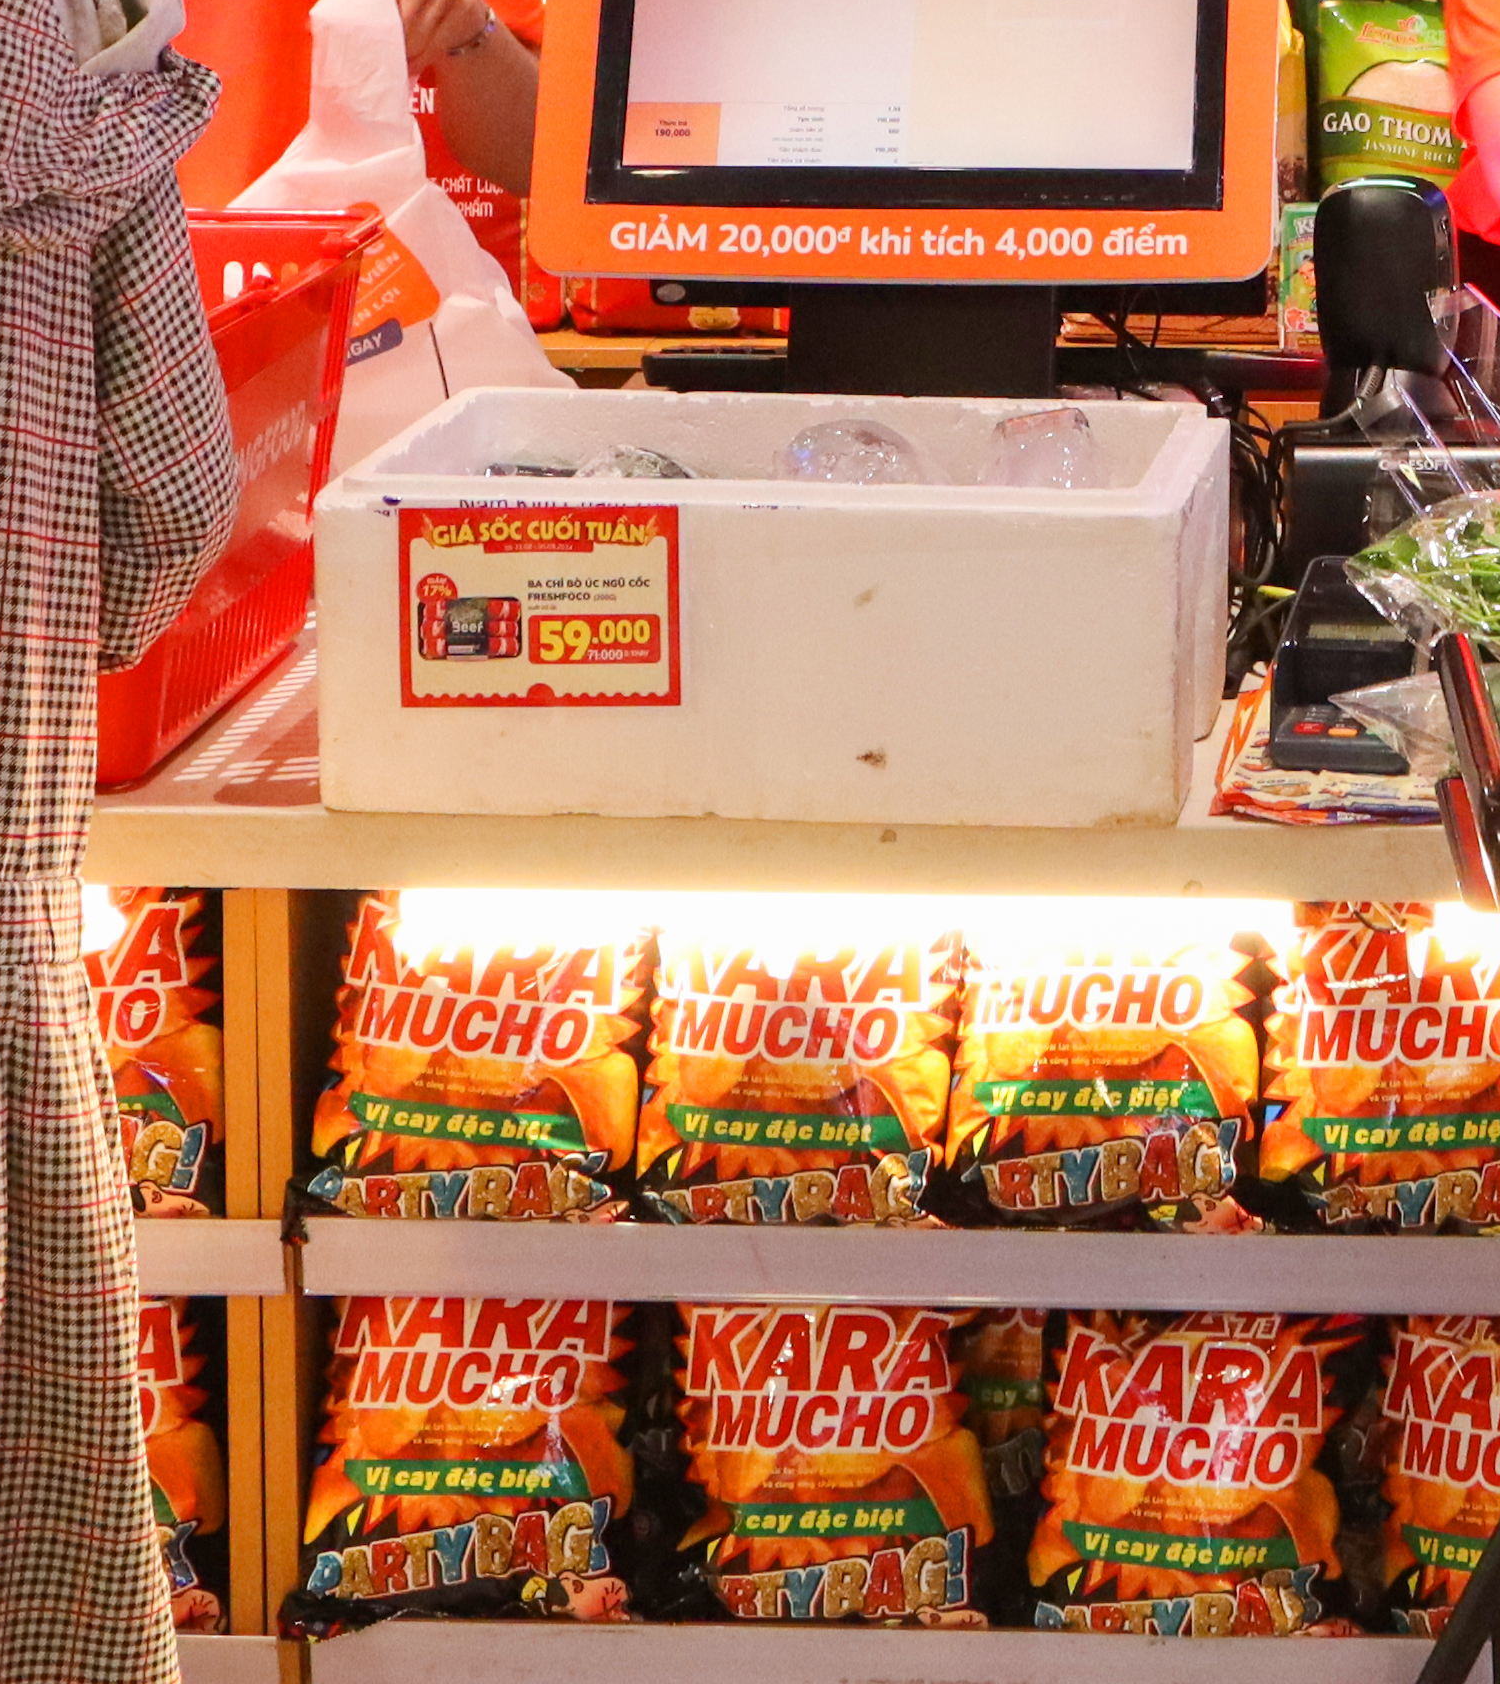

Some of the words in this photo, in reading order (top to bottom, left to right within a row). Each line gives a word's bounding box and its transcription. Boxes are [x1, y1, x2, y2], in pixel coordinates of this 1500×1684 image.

[1322, 112, 1372, 137] GẠO
[1378, 115, 1452, 147] THƠM
[1424, 146, 1456, 165] RICE
[609, 214, 707, 252] GIẢM
[859, 226, 912, 256] khi
[919, 226, 985, 256] tích
[994, 228, 1094, 261] 4,000
[1101, 222, 1189, 257] điểm
[431, 519, 476, 544] GIÁ
[479, 513, 522, 542] SỐC
[526, 513, 581, 541] CUỐI
[585, 516, 645, 545] TUẦN
[527, 579, 542, 589] BA
[566, 577, 582, 588] BÒ
[451, 620, 485, 633] Beef
[538, 618, 651, 663] 59.000
[972, 966, 1209, 1033] MUCHO
[355, 988, 596, 1067] MUCHO
[670, 990, 905, 1067] MUCHO
[1021, 1087, 1067, 1112] cay
[360, 1103, 392, 1133] Vị
[392, 1114, 441, 1137] cay
[445, 1114, 498, 1142] đặc
[682, 1112, 709, 1141] Vị
[712, 1117, 761, 1143] cay
[765, 1115, 816, 1143] đặc
[685, 1304, 954, 1400] KARA
[351, 1348, 584, 1412] MUCHO
[1055, 1330, 1323, 1436] KARA
[704, 1393, 936, 1454] MUCHO
[1068, 1422, 1301, 1489] MUCHO
[364, 1465, 389, 1490] Vị
[390, 1469, 439, 1493] cay
[441, 1465, 496, 1492] đặc
[498, 1464, 552, 1490] biệt
[745, 1511, 790, 1533] cay
[793, 1504, 844, 1533] đặc
[851, 1505, 906, 1531] biệt
[307, 1495, 613, 1603] PARTYBAG!
[1083, 1530, 1109, 1556] Vị
[1112, 1536, 1160, 1563] cay
[1162, 1536, 1213, 1567] đặc
[1218, 1539, 1270, 1566] biệt
